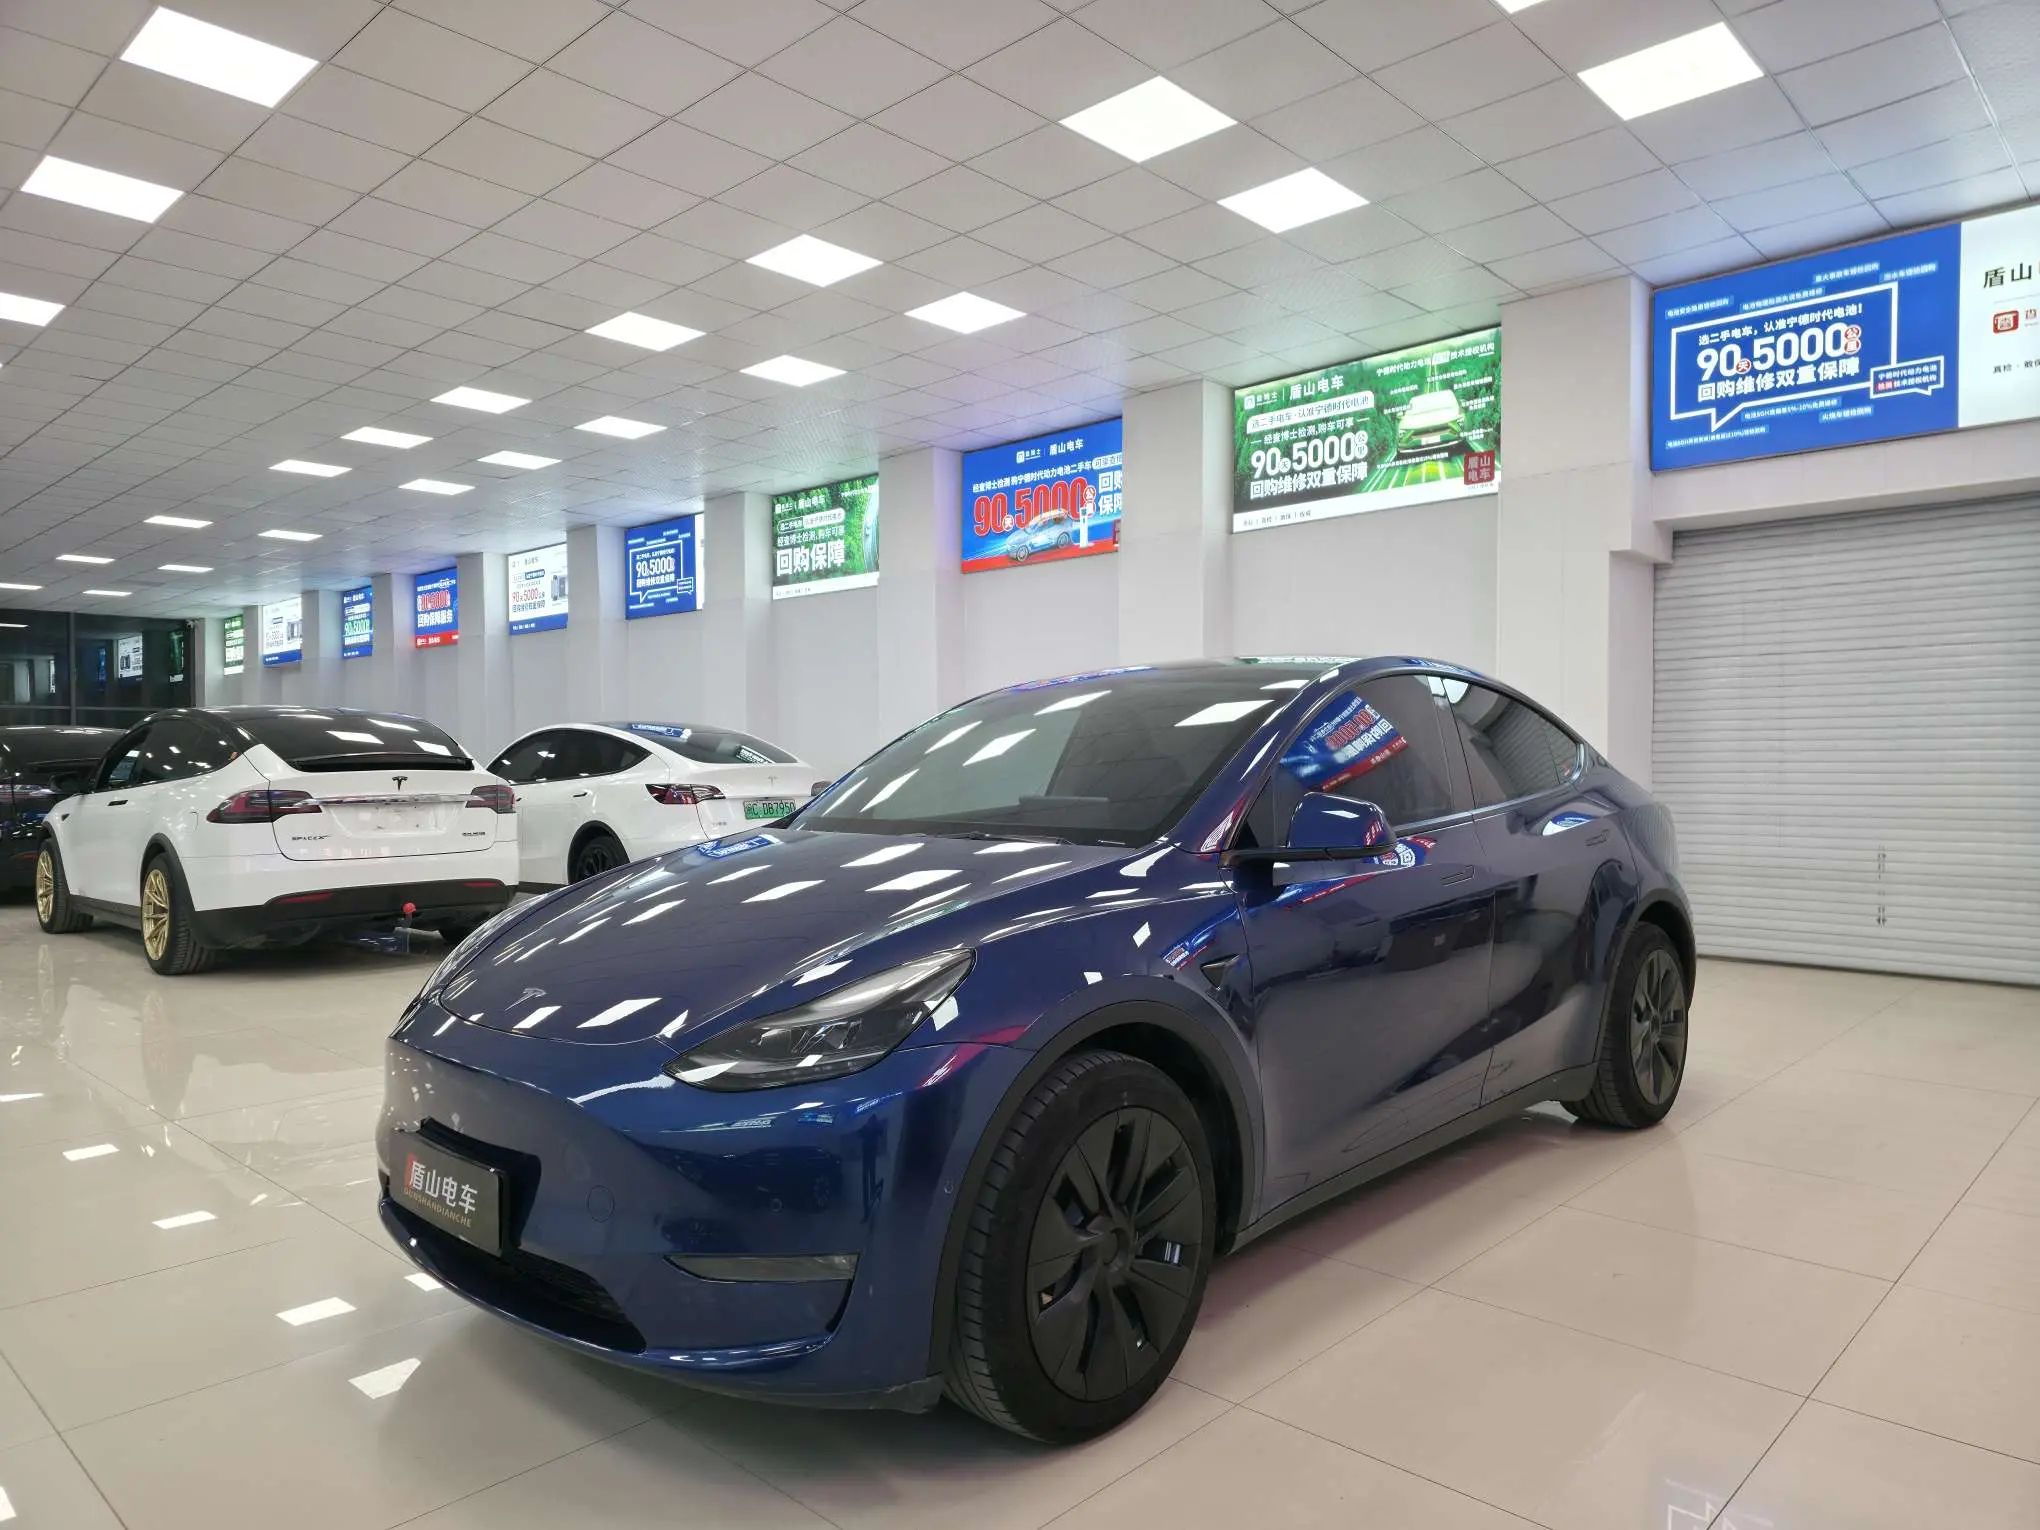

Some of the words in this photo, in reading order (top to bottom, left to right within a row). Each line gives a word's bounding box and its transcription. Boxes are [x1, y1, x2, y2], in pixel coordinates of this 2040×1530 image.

[1983, 260, 2040, 289] 盾山
[1290, 375, 1344, 401] 盾山电车
[1697, 356, 1860, 402] 回购维修双重保障
[1049, 438, 1084, 456] 盾山电车
[1250, 461, 1368, 500] 回购维修双重保障
[776, 539, 846, 577] 回购保障
[410, 1161, 478, 1214] 盾山电车
